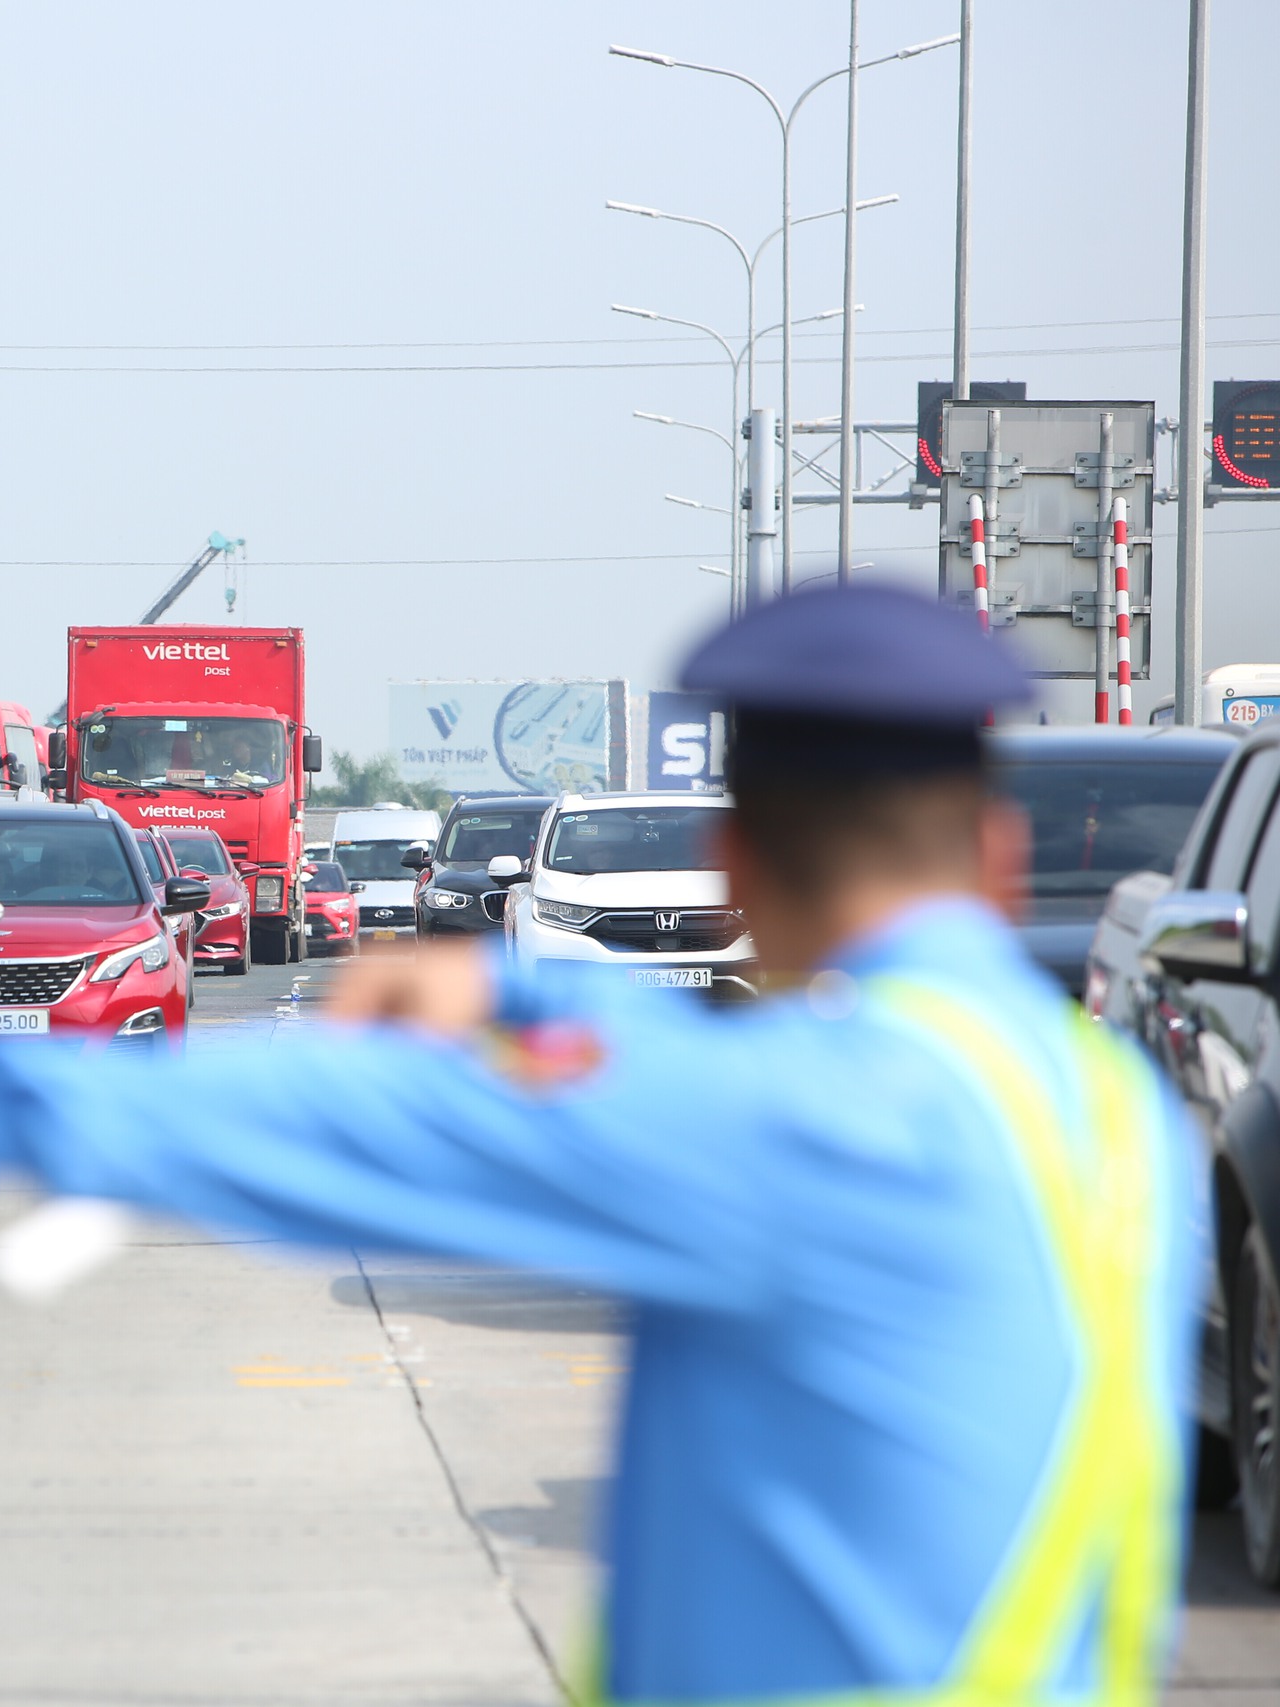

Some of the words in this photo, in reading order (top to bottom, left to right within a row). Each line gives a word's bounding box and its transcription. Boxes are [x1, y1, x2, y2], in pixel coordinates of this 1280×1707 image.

[142, 642, 230, 661] viettel
[204, 666, 231, 676] post
[1231, 705, 1256, 721] 215
[138, 805, 195, 819] viettel
[197, 808, 226, 820] post
[636, 971, 708, 986] 30G-477.91
